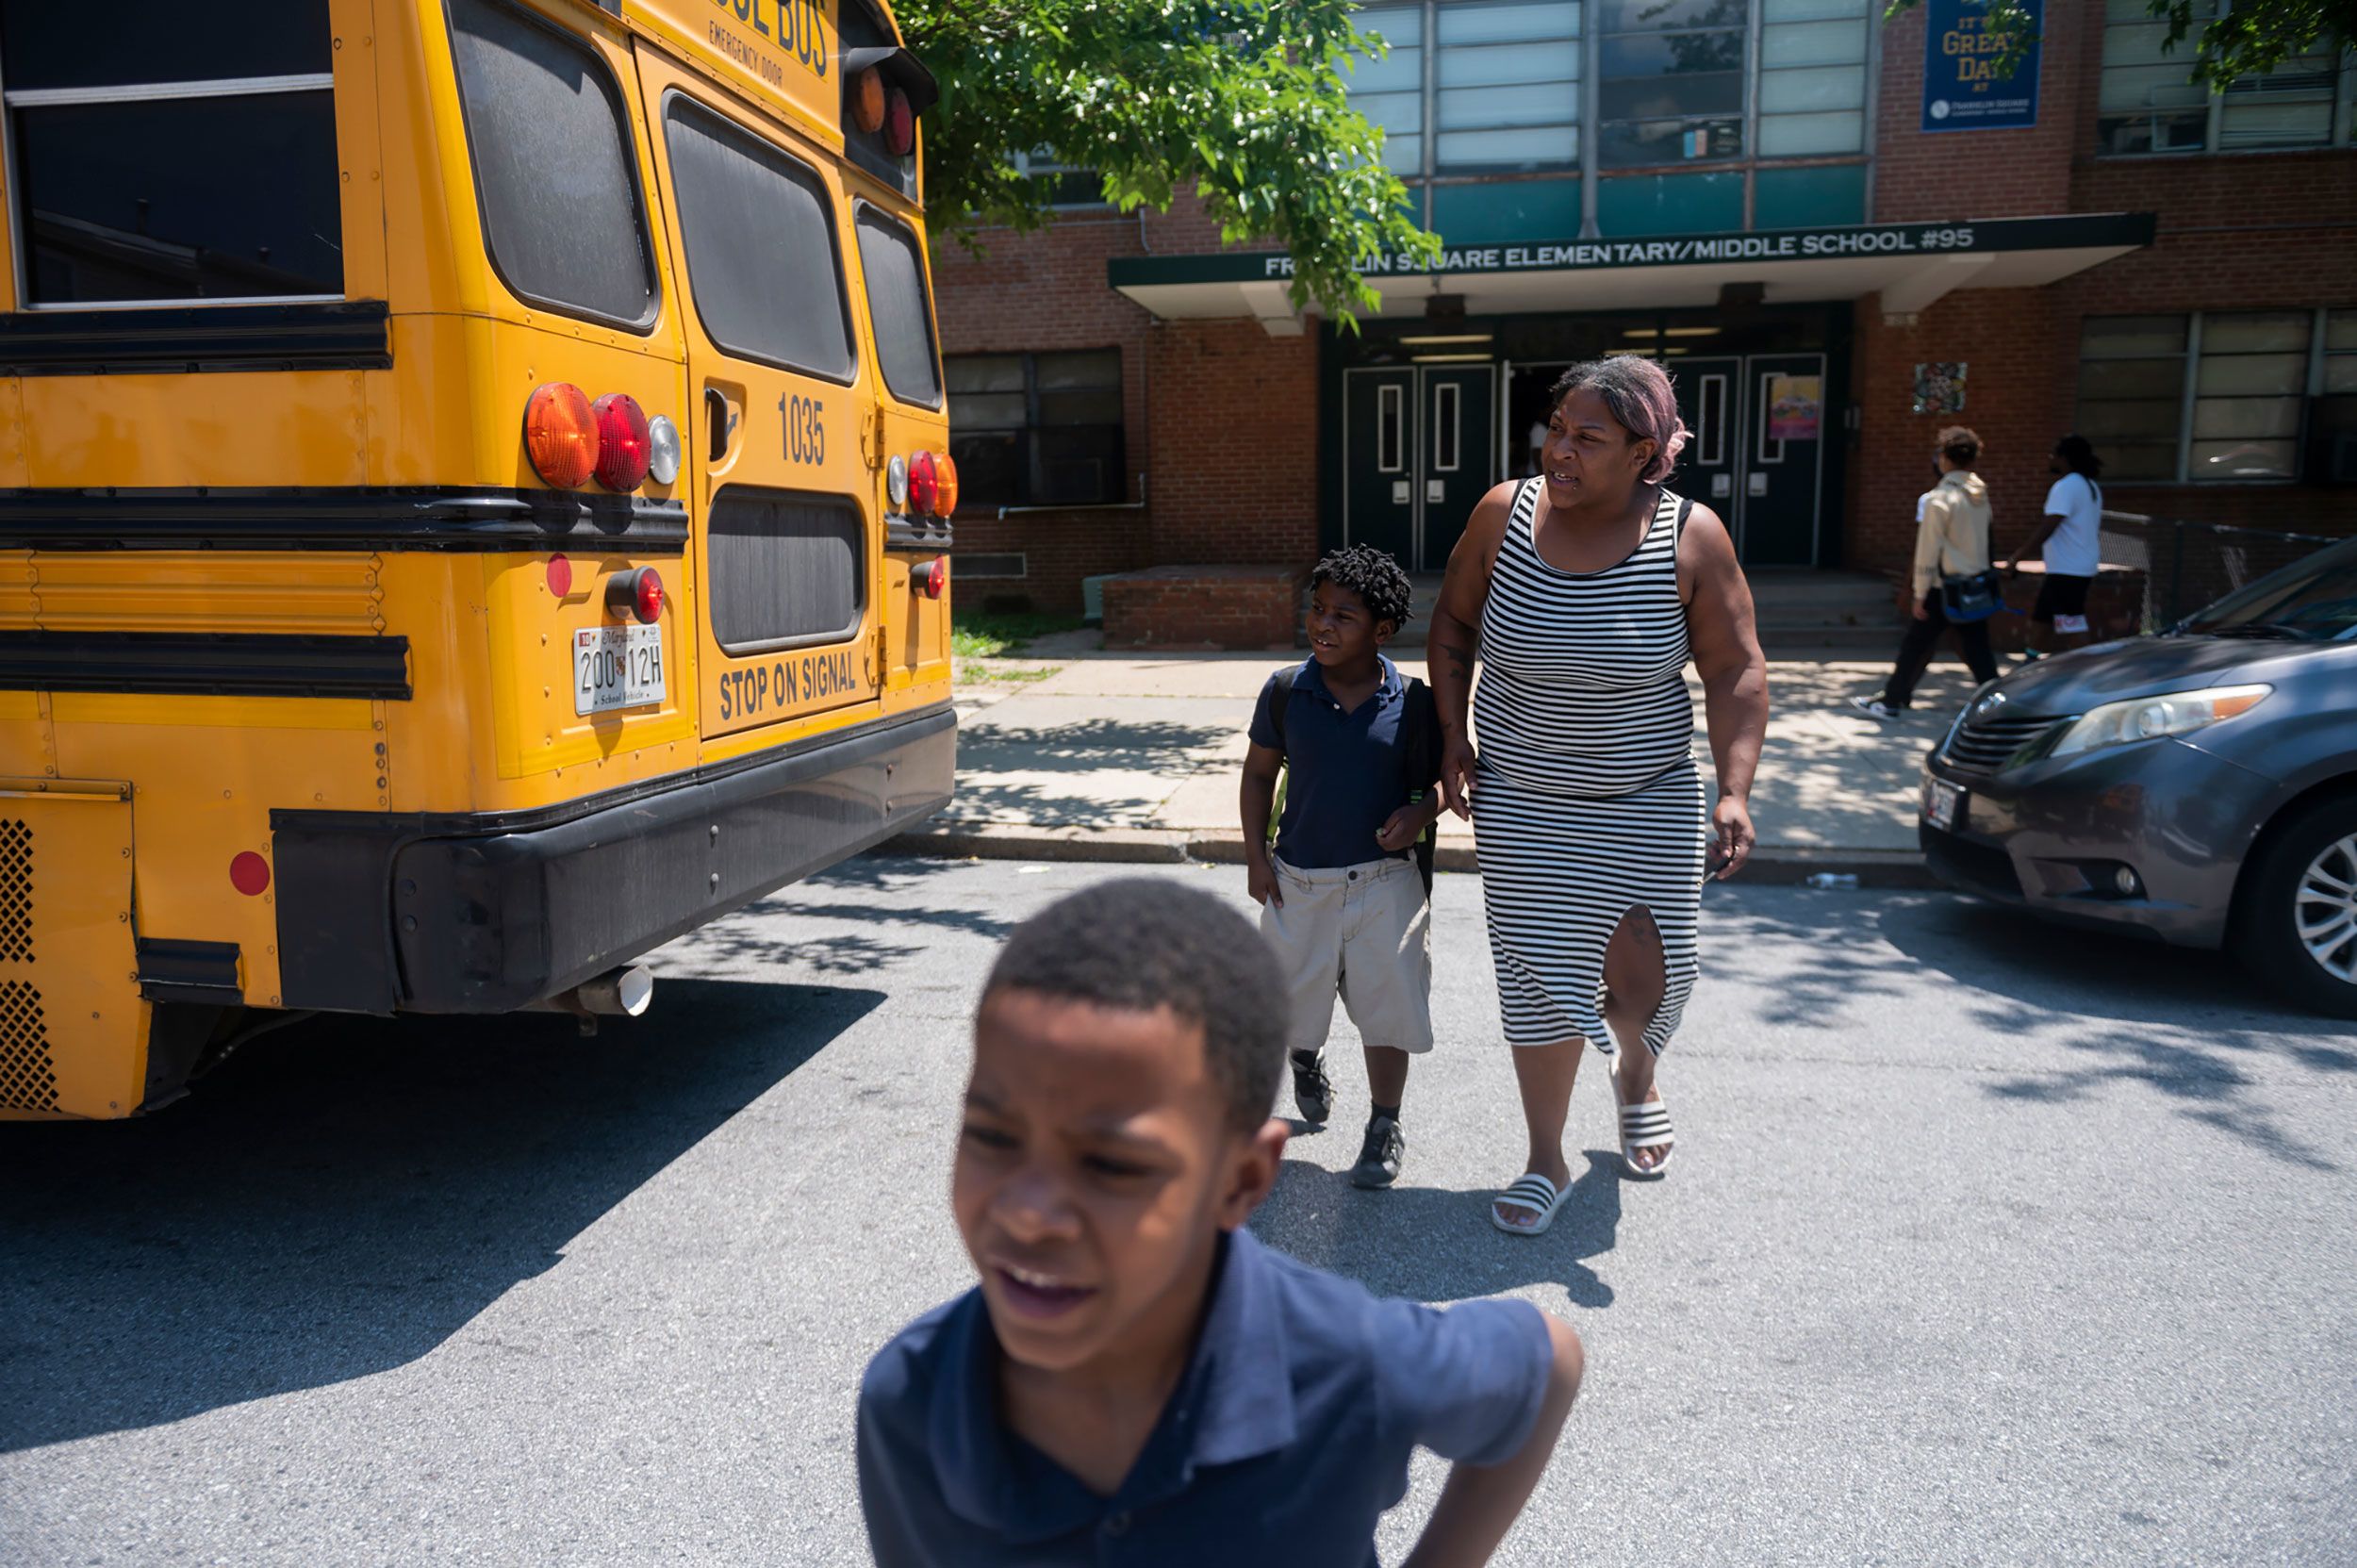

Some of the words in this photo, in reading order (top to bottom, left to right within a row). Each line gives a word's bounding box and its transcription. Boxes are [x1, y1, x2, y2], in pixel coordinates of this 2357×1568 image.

[709, 20, 759, 73] EMERGENCY
[761, 56, 783, 89] DOOR
[1942, 30, 2020, 55] GREA
[1956, 57, 2008, 81] DA
[1265, 253, 1392, 276] FRLIN
[1505, 236, 1796, 266] ELEMENTARY/MIDDLE
[1801, 231, 1915, 255] SCHOOL
[1920, 228, 1974, 248] #95
[779, 392, 824, 467] 1035
[581, 650, 615, 691] 200
[629, 645, 662, 687] 12H
[720, 666, 767, 720] STOP
[774, 661, 798, 707] ON
[803, 651, 856, 701] SIGNAL
[601, 692, 622, 705] School
